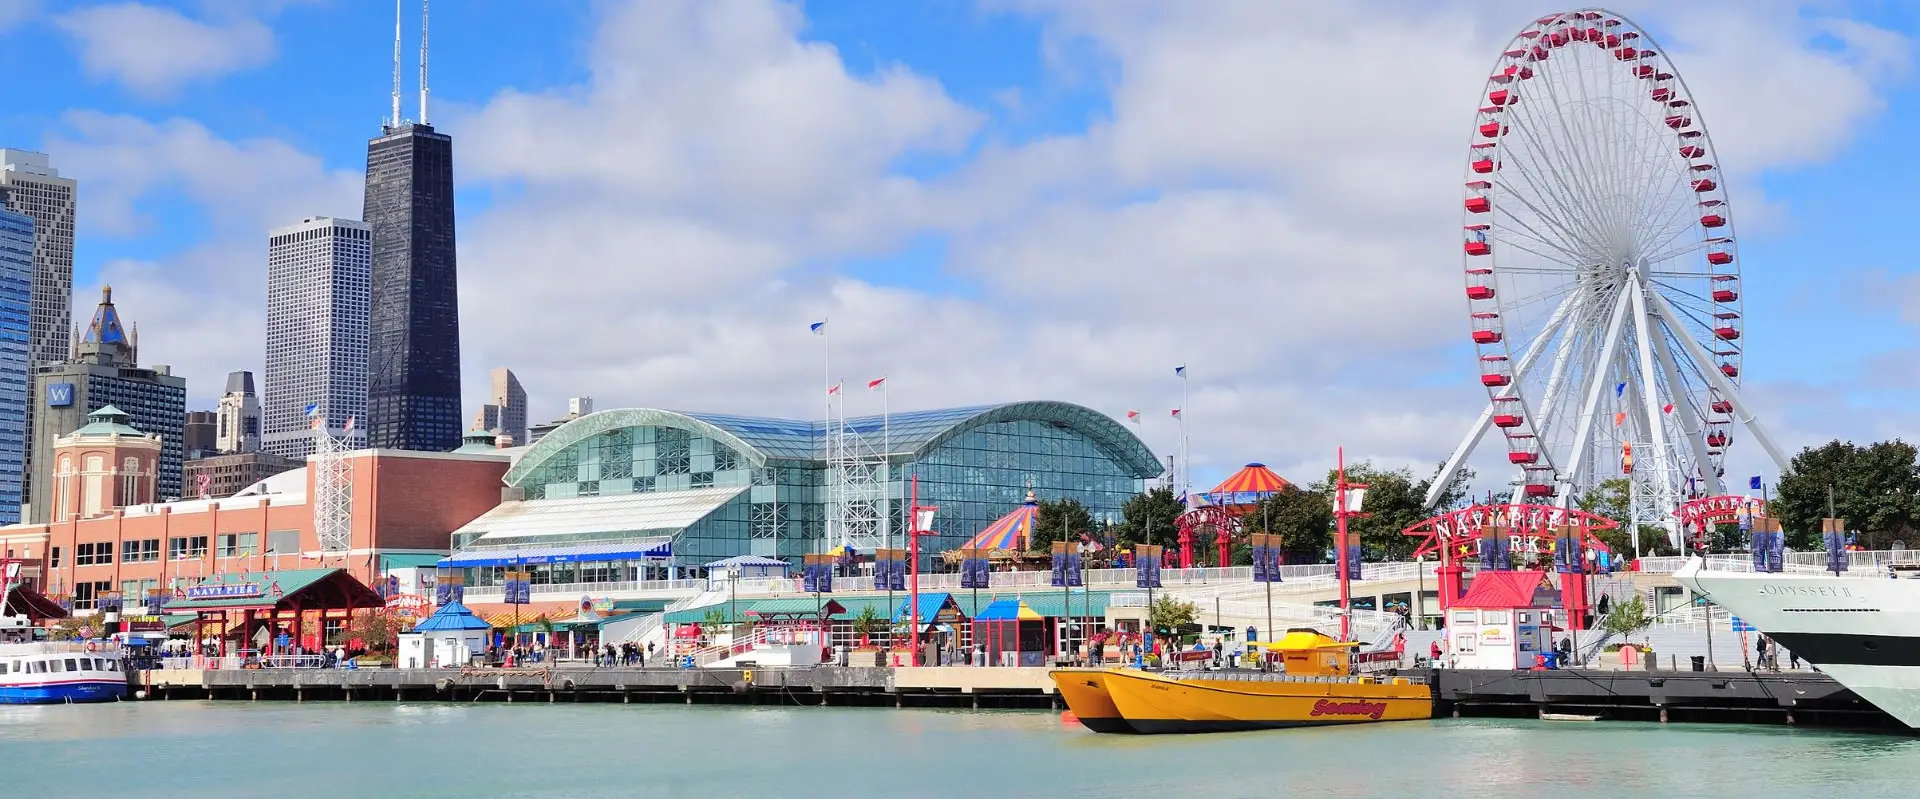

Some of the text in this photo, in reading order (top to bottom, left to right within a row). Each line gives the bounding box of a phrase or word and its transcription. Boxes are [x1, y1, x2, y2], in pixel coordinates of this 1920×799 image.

[51, 387, 69, 401] W
[1687, 499, 1728, 519] NAVY
[1436, 512, 1503, 540] NAVY
[193, 585, 253, 596] NAVY PIER
[1764, 584, 1837, 597] ODYSSEY
[1309, 699, 1387, 719] Seadog
